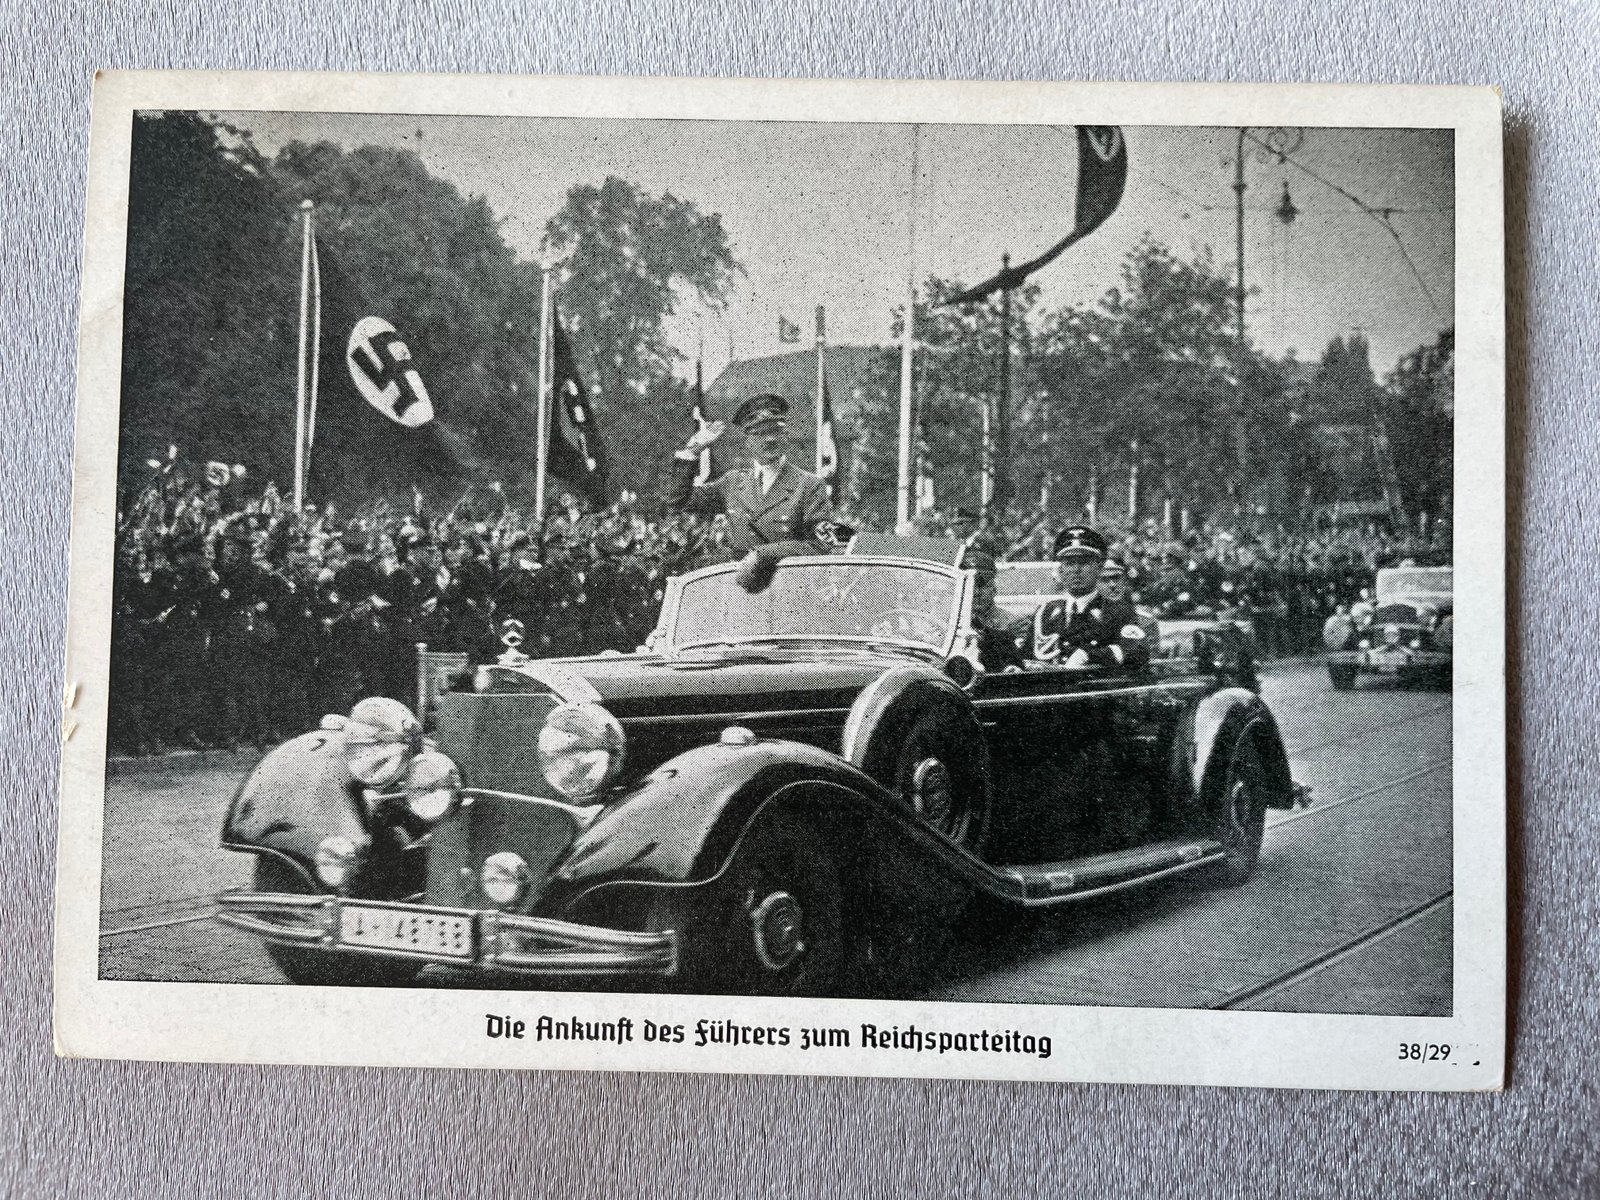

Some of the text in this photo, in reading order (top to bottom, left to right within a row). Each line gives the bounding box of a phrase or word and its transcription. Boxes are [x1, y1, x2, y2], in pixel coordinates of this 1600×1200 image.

[485, 1013, 1052, 1059] Die Ankunft des Führers zum Reichsparteitag
[1398, 1043, 1451, 1064] 38/29
